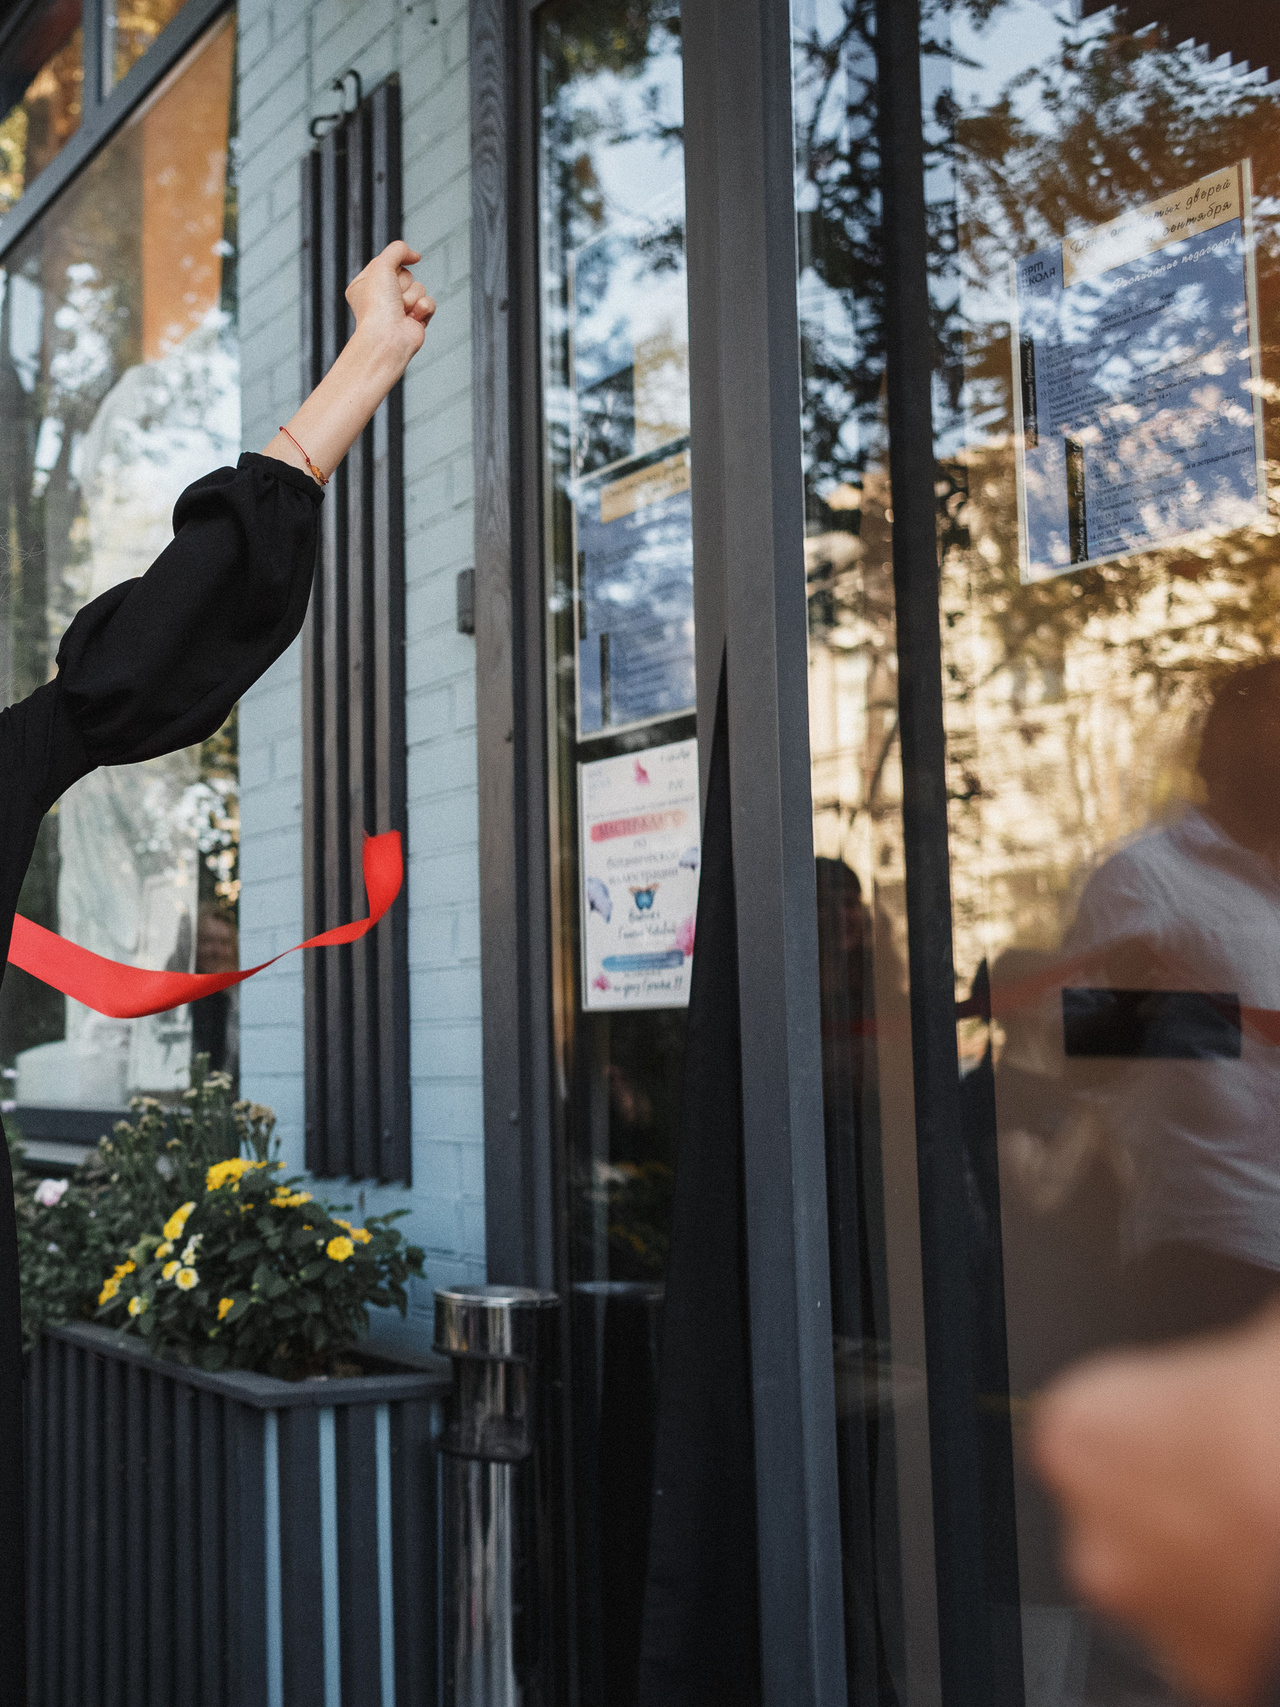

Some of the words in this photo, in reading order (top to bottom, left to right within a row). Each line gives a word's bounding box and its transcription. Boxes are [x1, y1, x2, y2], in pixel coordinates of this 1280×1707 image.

[1185, 179, 1231, 210] дверей
[1162, 200, 1232, 237] сентября
[1113, 261, 1178, 291] Расписание
[1181, 232, 1236, 265] педагогов
[1196, 453, 1230, 467] эстрадный
